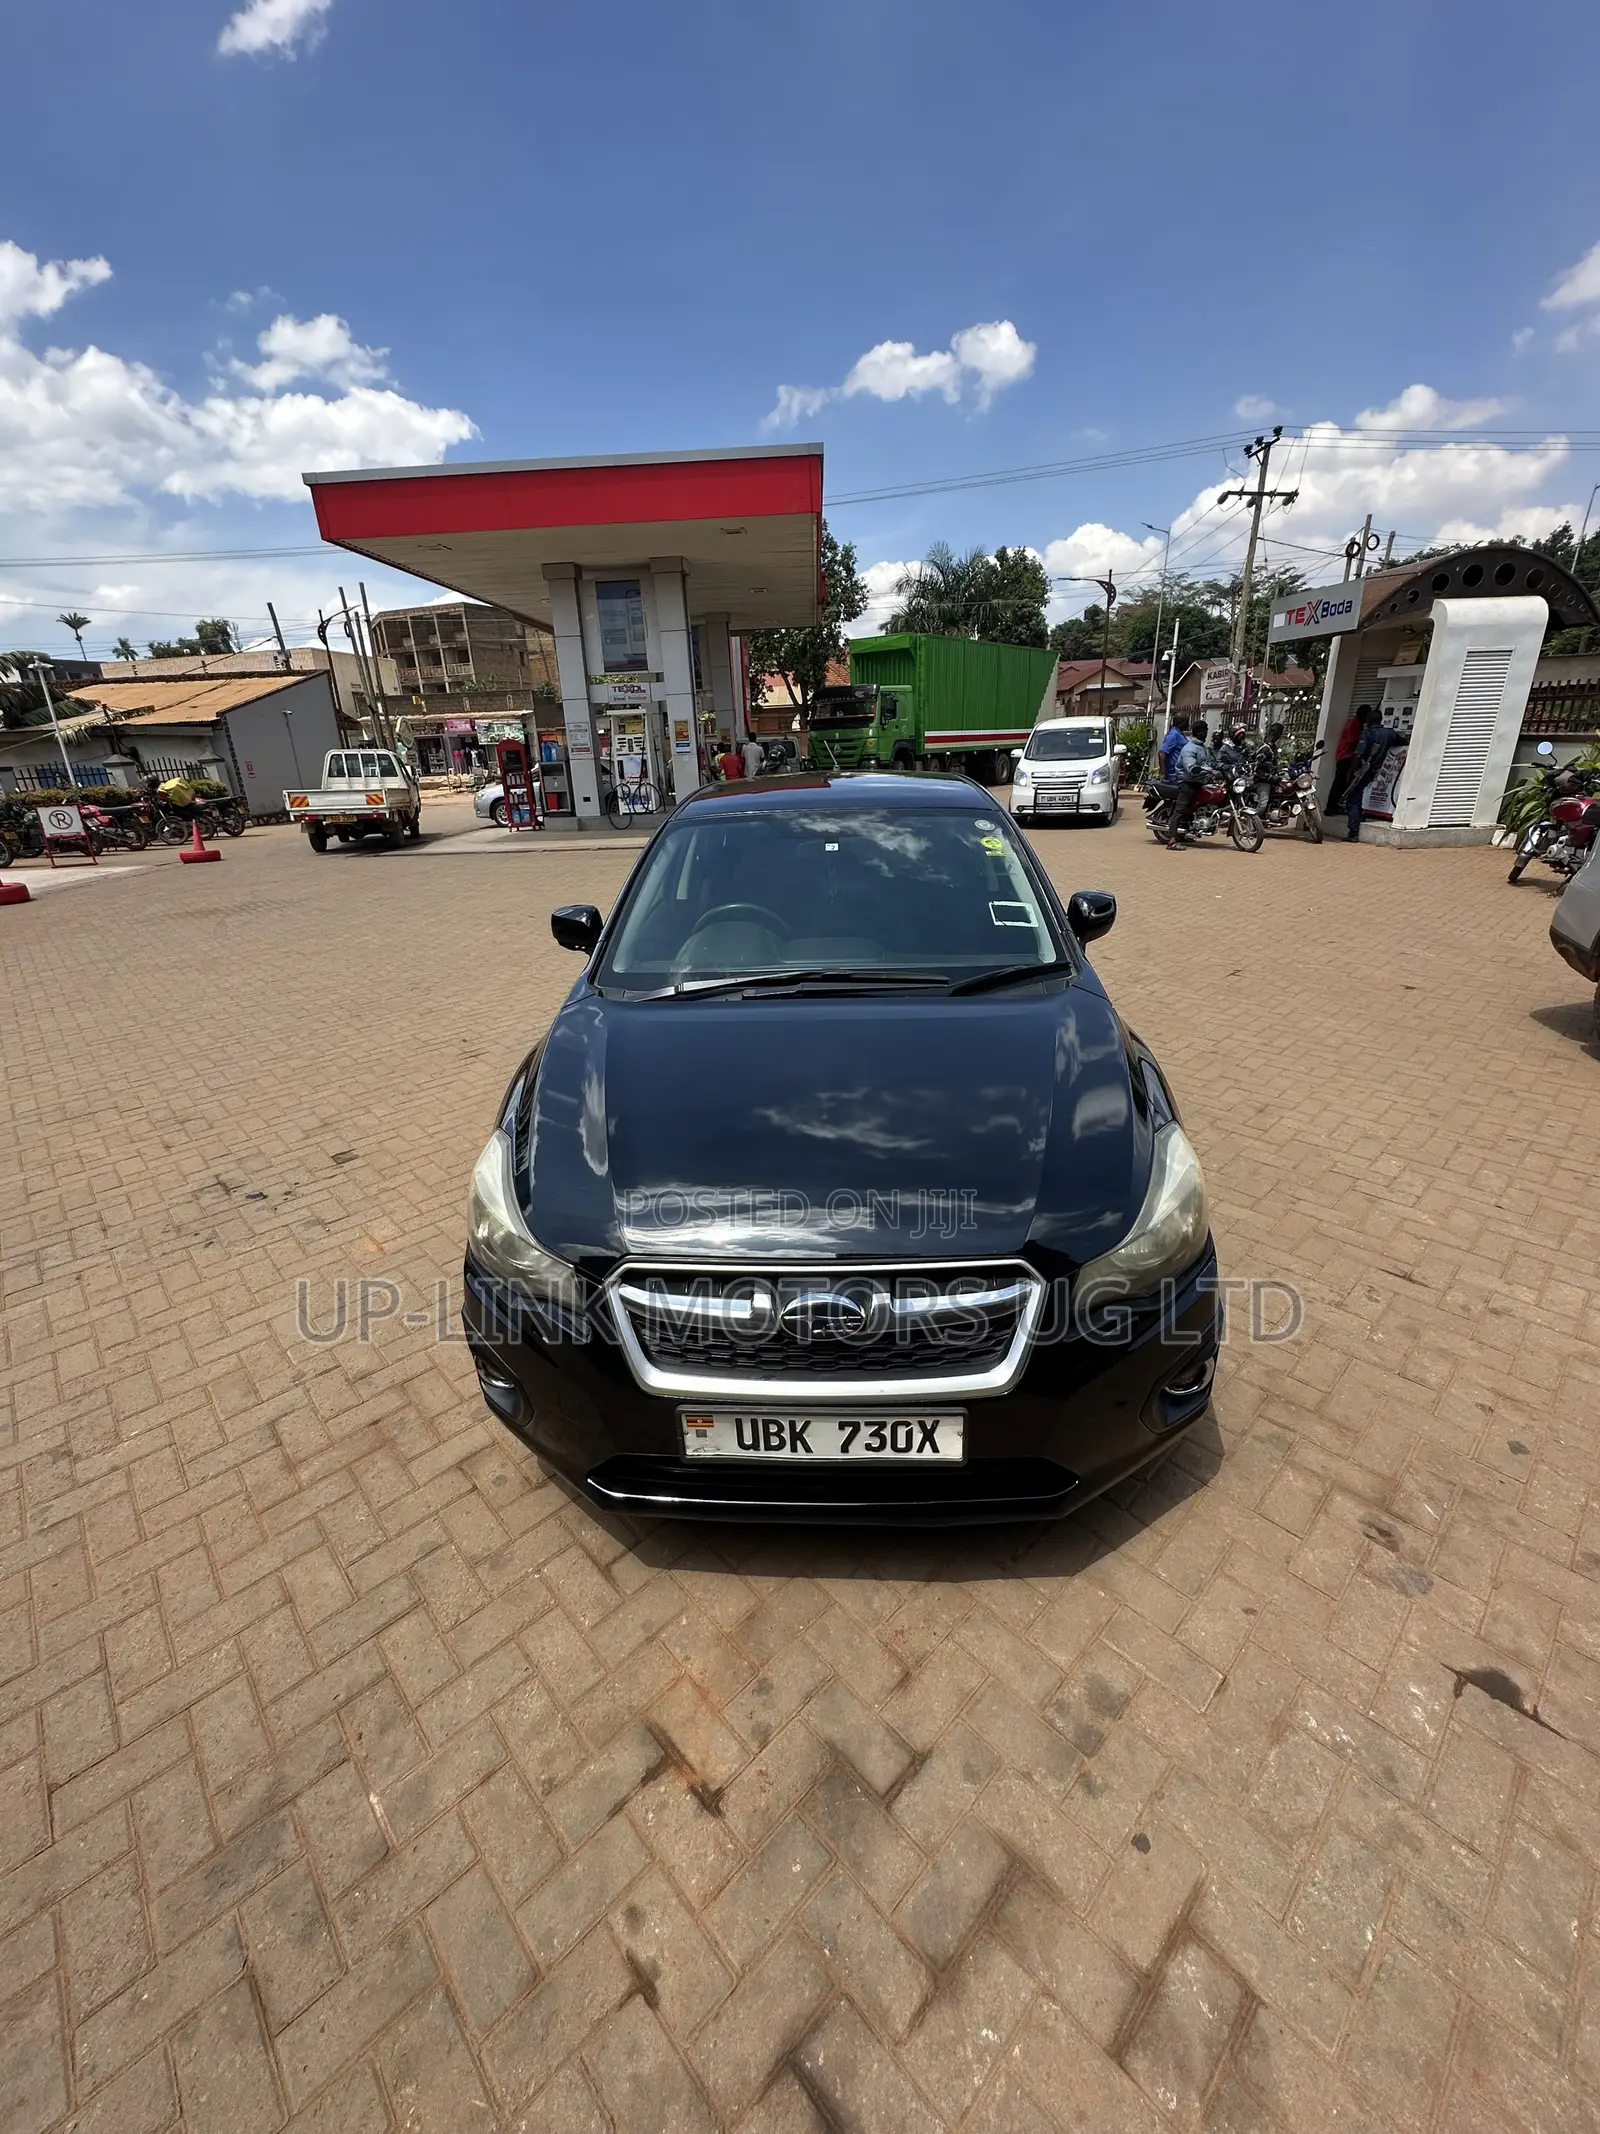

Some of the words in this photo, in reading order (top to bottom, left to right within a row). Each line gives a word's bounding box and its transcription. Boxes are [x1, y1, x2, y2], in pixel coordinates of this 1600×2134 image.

[611, 684, 647, 694] TEXOL
[734, 1417, 814, 1454] UBK
[838, 1419, 941, 1454] 730X
